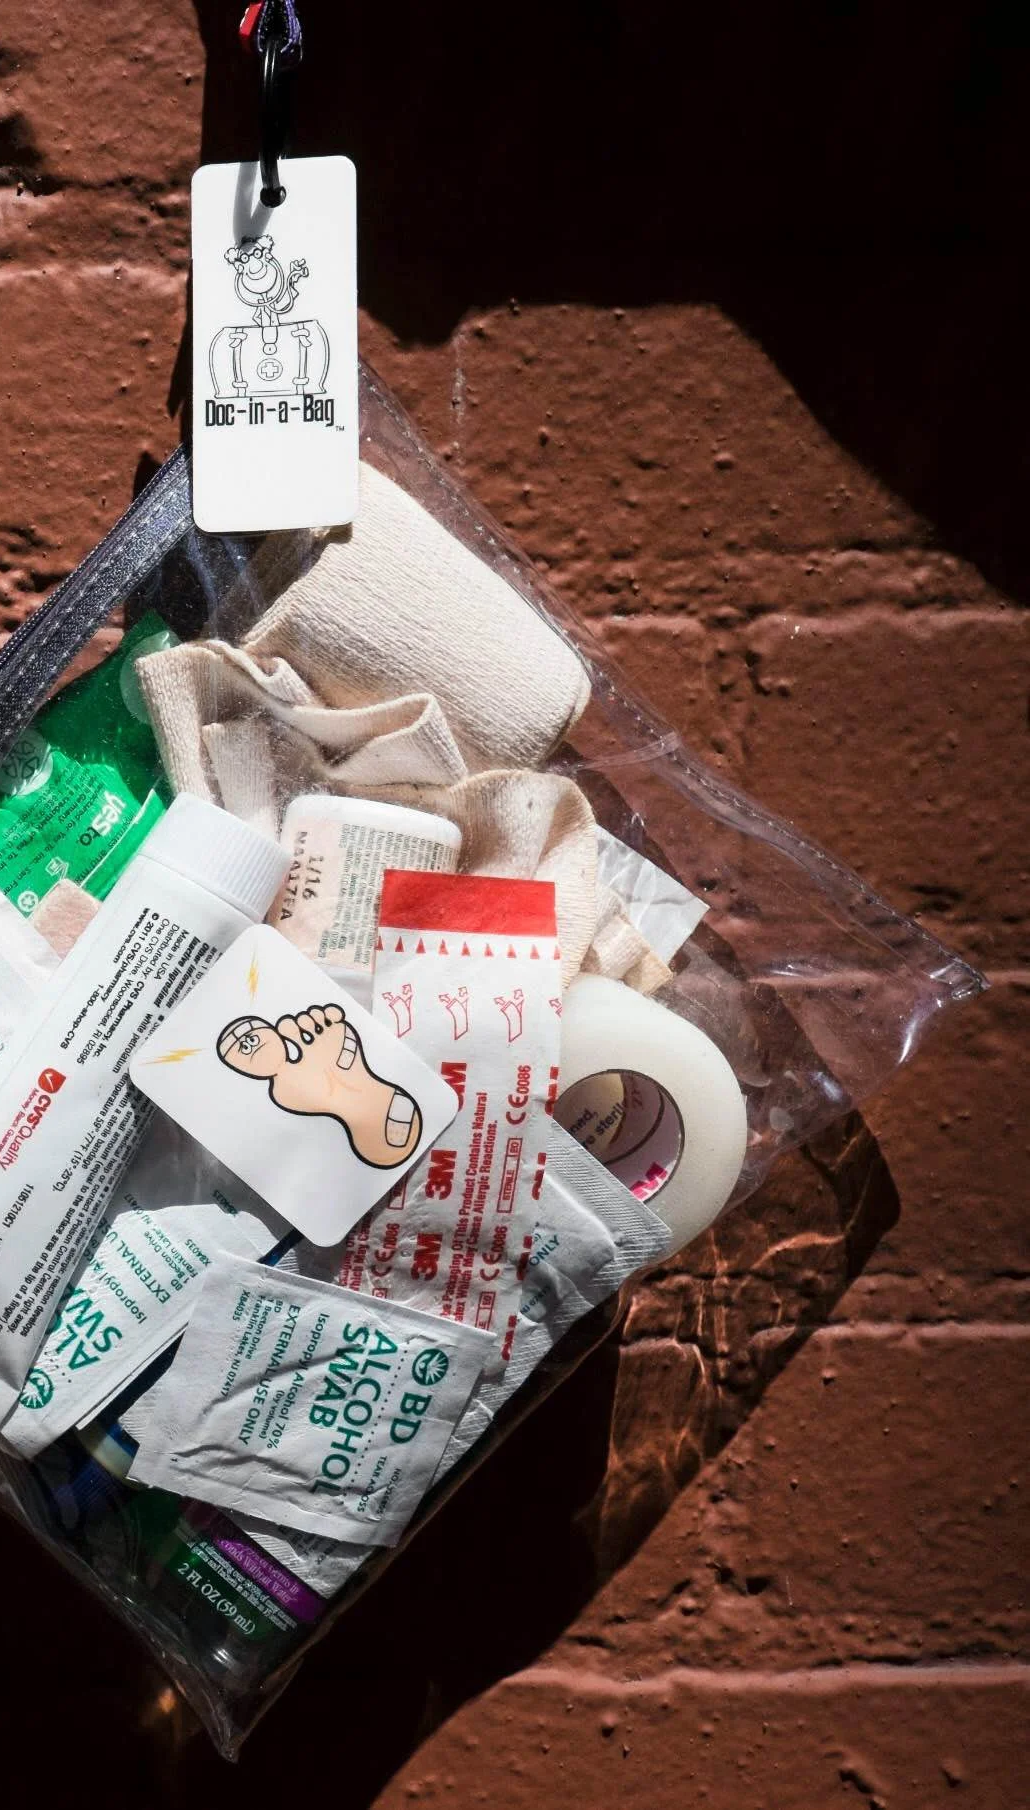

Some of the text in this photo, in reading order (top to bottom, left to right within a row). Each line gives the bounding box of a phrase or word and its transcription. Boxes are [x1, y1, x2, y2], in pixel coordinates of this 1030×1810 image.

[205, 395, 335, 427] Doc-in-a-Bag
[137, 920, 154, 941] 2011
[155, 917, 170, 935] One
[170, 929, 188, 952] Made
[143, 935, 159, 954] CVS
[148, 923, 179, 966] Distributed
[192, 942, 209, 964] Other
[204, 947, 217, 963] area
[58, 906, 151, 1049] www.cvs.com 1-800-shop-CVS
[98, 941, 142, 1002] CVS/pharmacy
[153, 961, 169, 980] USA
[129, 980, 145, 999] CVS
[164, 964, 196, 1008] information
[97, 978, 133, 1028] Woonsocket,
[110, 936, 201, 1074] Inactive ingredient white petrolatum
[100, 998, 133, 1043] Pharmacy,
[75, 1038, 96, 1065] 02895
[91, 1042, 106, 1059] Inc.
[439, 1061, 468, 1111] M
[514, 1064, 531, 1093] 0086
[21, 1087, 39, 1111] Money
[99, 1114, 119, 1138] sterile
[117, 1110, 133, 1131] small
[80, 1137, 104, 1170] bandage
[99, 1131, 120, 1160] amount
[113, 1128, 134, 1158] medical
[84, 1160, 103, 1185] (equal
[102, 1157, 117, 1175] help
[627, 1160, 668, 1201] M
[2, 1183, 34, 1227] 11051210C1
[72, 1194, 84, 1207] the
[81, 1184, 102, 1212] contact
[442, 1091, 487, 1301] Packaging Of This Product Contains Natural
[55, 1207, 76, 1235] surface
[409, 1146, 457, 1282] 3M 3M
[455, 1119, 497, 1321] atex Which May Cause Allergic Reactions.
[45, 1235, 58, 1251] area
[62, 1218, 82, 1245] Poison
[142, 1230, 162, 1252] Drive
[491, 1225, 507, 1252] 0086
[31, 1260, 43, 1274] the
[46, 1244, 68, 1273] Control
[114, 1239, 170, 1304] EXTERNAL
[159, 1250, 185, 1279] Becton
[168, 1245, 198, 1279] Franklin
[31, 1272, 51, 1297] Center
[40, 1275, 61, 1305] reaction
[98, 1270, 148, 1324] Isopropyl
[169, 1277, 183, 1291] BD
[19, 1295, 35, 1315] right
[273, 1300, 283, 1313] BD
[6, 1312, 23, 1335] away.
[19, 1304, 44, 1337] develops
[254, 1305, 271, 1335] Becton
[220, 1294, 265, 1396] Franklin Lakes, NJ 07417
[245, 1336, 259, 1360] Drive
[236, 1303, 301, 1445] EXTERNAL USE ONLY
[266, 1311, 329, 1450] Isopropyl Alcohol 70%
[306, 1320, 371, 1432] SWAB
[258, 1389, 284, 1439] (by volume)
[309, 1328, 401, 1503] ALCOHOL
[385, 1386, 432, 1449] BD
[370, 1453, 387, 1477] TEAR
[176, 1561, 190, 1576] 2
[185, 1569, 204, 1588] FL
[199, 1581, 221, 1603] OZ
[214, 1596, 238, 1620] (59
[231, 1611, 257, 1636] mL)
